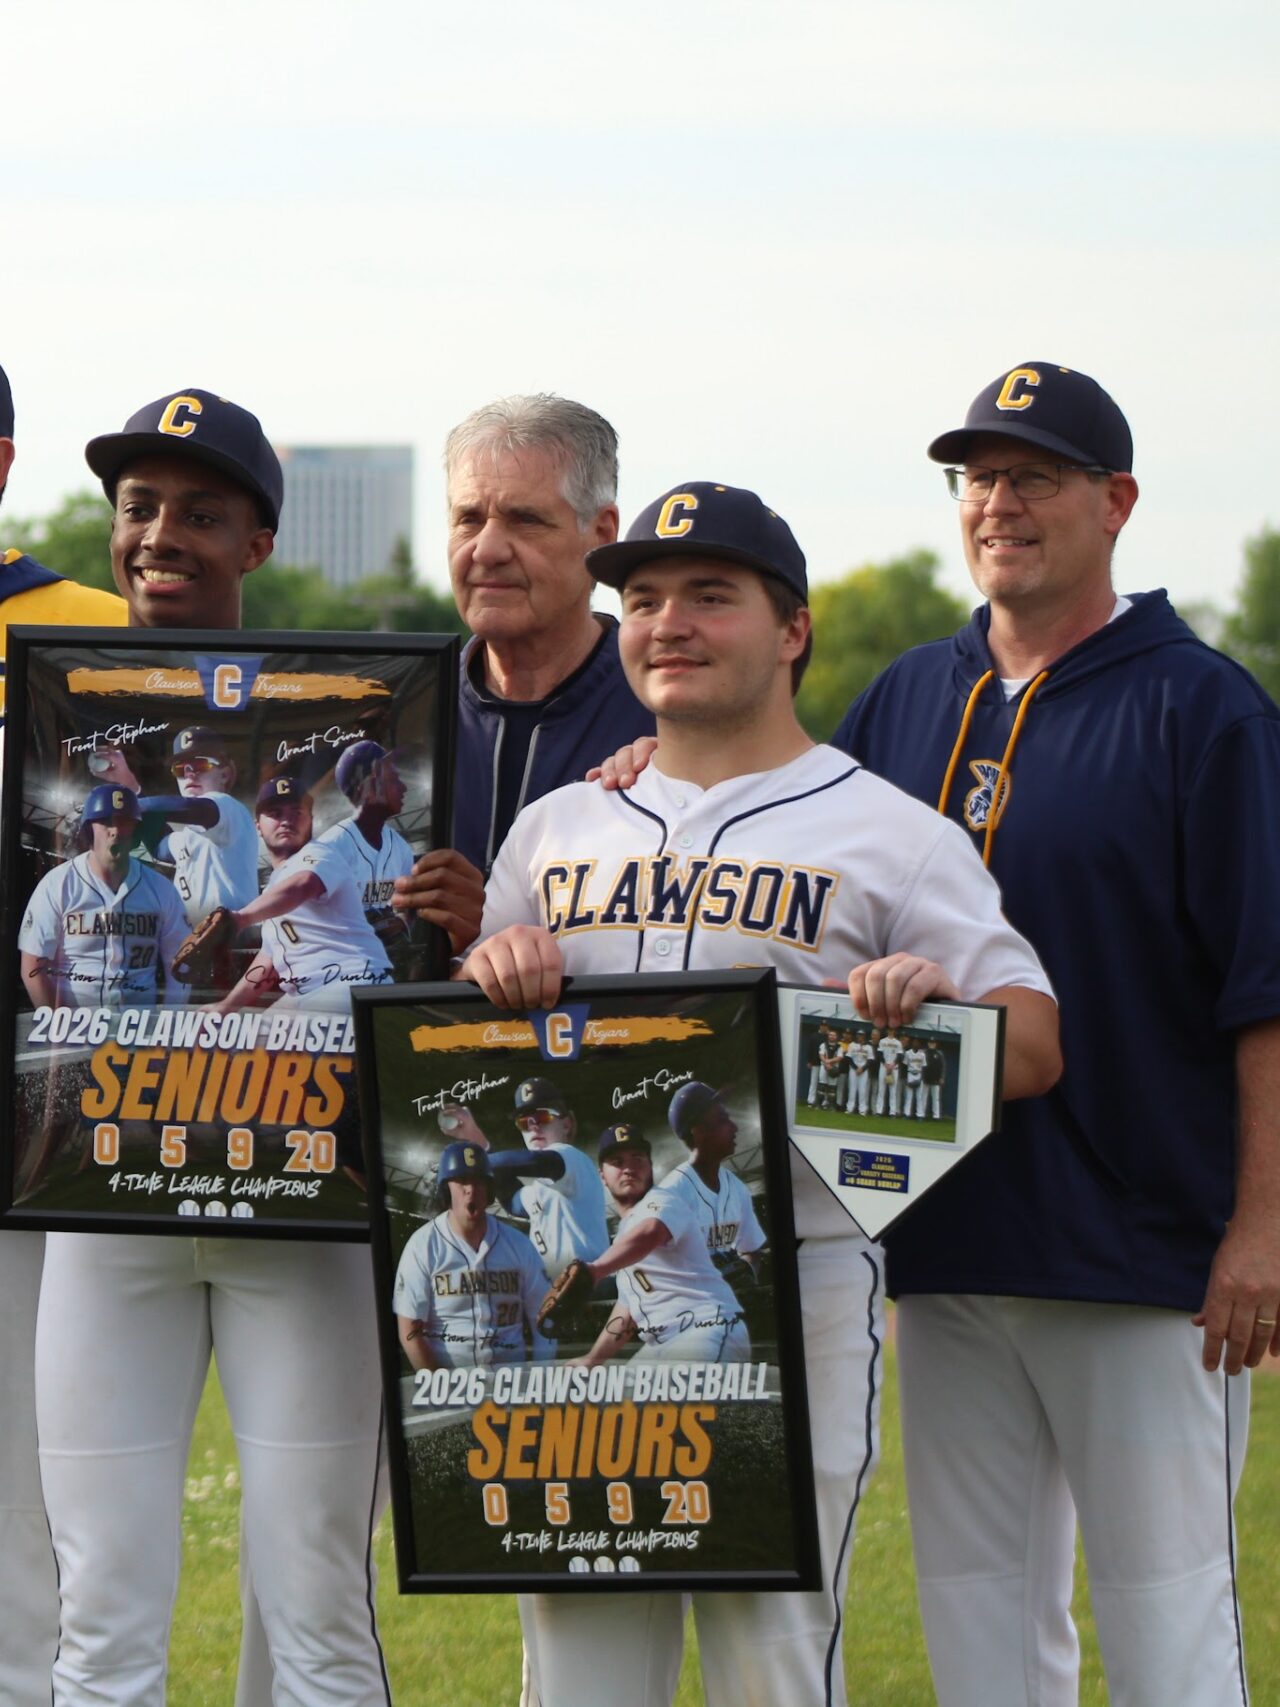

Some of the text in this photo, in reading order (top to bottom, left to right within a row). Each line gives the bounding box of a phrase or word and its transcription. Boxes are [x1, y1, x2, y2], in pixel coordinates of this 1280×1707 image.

[996, 368, 1040, 411] C
[158, 396, 203, 438] C
[655, 494, 699, 539] C
[145, 664, 303, 708] Clawson C Trojans
[61, 718, 170, 758] Trent Stephan
[180, 731, 194, 750] C
[277, 725, 366, 762] Grant Sims
[112, 790, 124, 809] C
[276, 778, 290, 795] C
[539, 852, 840, 953] CLAWSON
[67, 913, 158, 938] CLAWSON
[27, 1006, 112, 1046] 2026
[116, 1009, 262, 1051] CLAWSON
[483, 1012, 629, 1058] Clawson C Trojans
[80, 1042, 354, 1127] SENIORS
[93, 1123, 336, 1174] 0 5 9 20
[614, 1127, 629, 1143] C
[463, 1147, 475, 1166] C
[108, 1171, 321, 1199] 4-TIME LEAGUE CHAMPIONS
[434, 1269, 520, 1296] CLAWSON
[412, 1362, 771, 1406] 2026 CLAWSON BASEBALL
[467, 1400, 717, 1480] SENIORS
[482, 1480, 711, 1526] 0 5 9 20
[501, 1530, 699, 1554] 4-TIME LEAGUE CHAMPIONS
